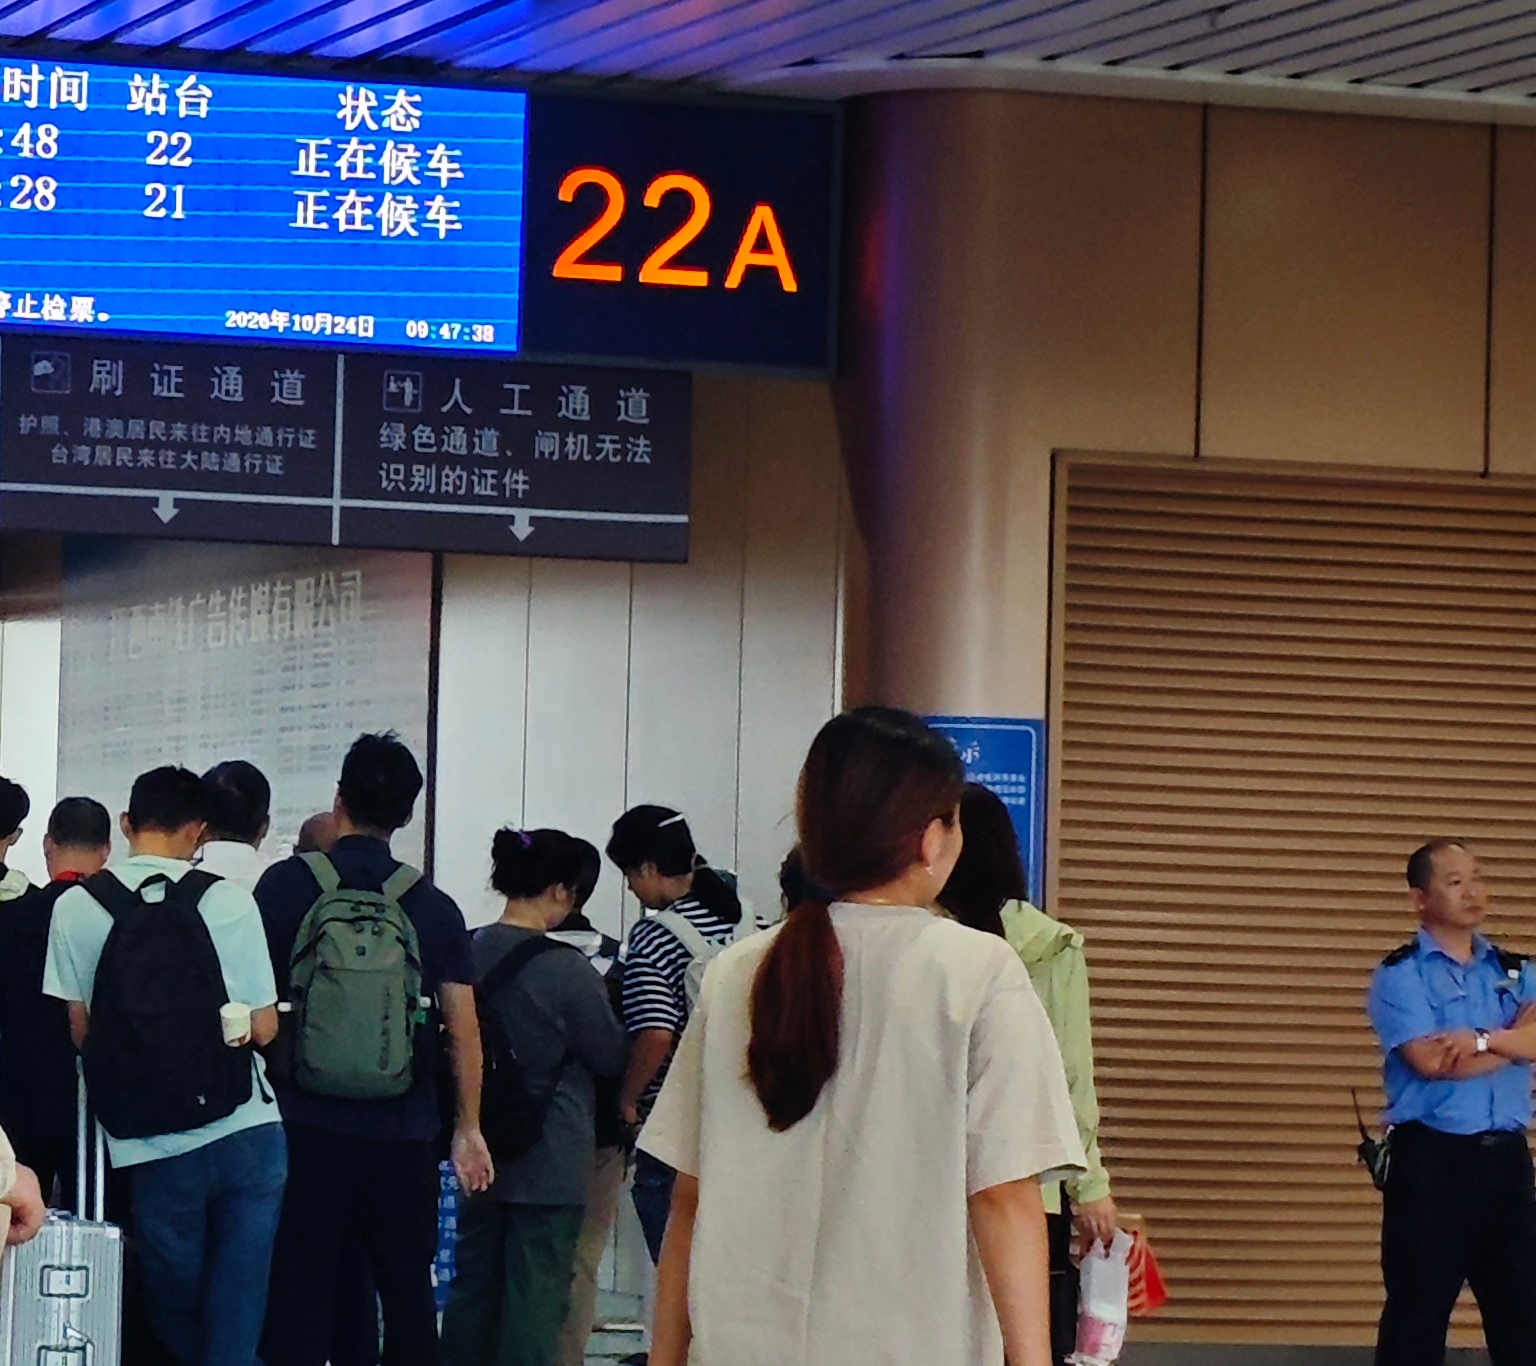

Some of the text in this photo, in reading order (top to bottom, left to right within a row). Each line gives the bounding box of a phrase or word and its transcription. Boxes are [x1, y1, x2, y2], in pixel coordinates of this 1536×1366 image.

[127, 74, 212, 117] 站台
[337, 86, 421, 131] 状态
[147, 131, 192, 166] 22
[294, 137, 464, 190] 正在候车
[144, 183, 184, 218] 21
[292, 189, 462, 239] 正在候车
[552, 166, 797, 292] 22A
[226, 310, 494, 342] 2026年10月24日 09:47:38
[89, 360, 305, 405] 刷证通道
[441, 383, 649, 424] 人工通道
[380, 421, 652, 464] 绿色通道、闸机无法
[379, 463, 529, 501] 识别的证件
